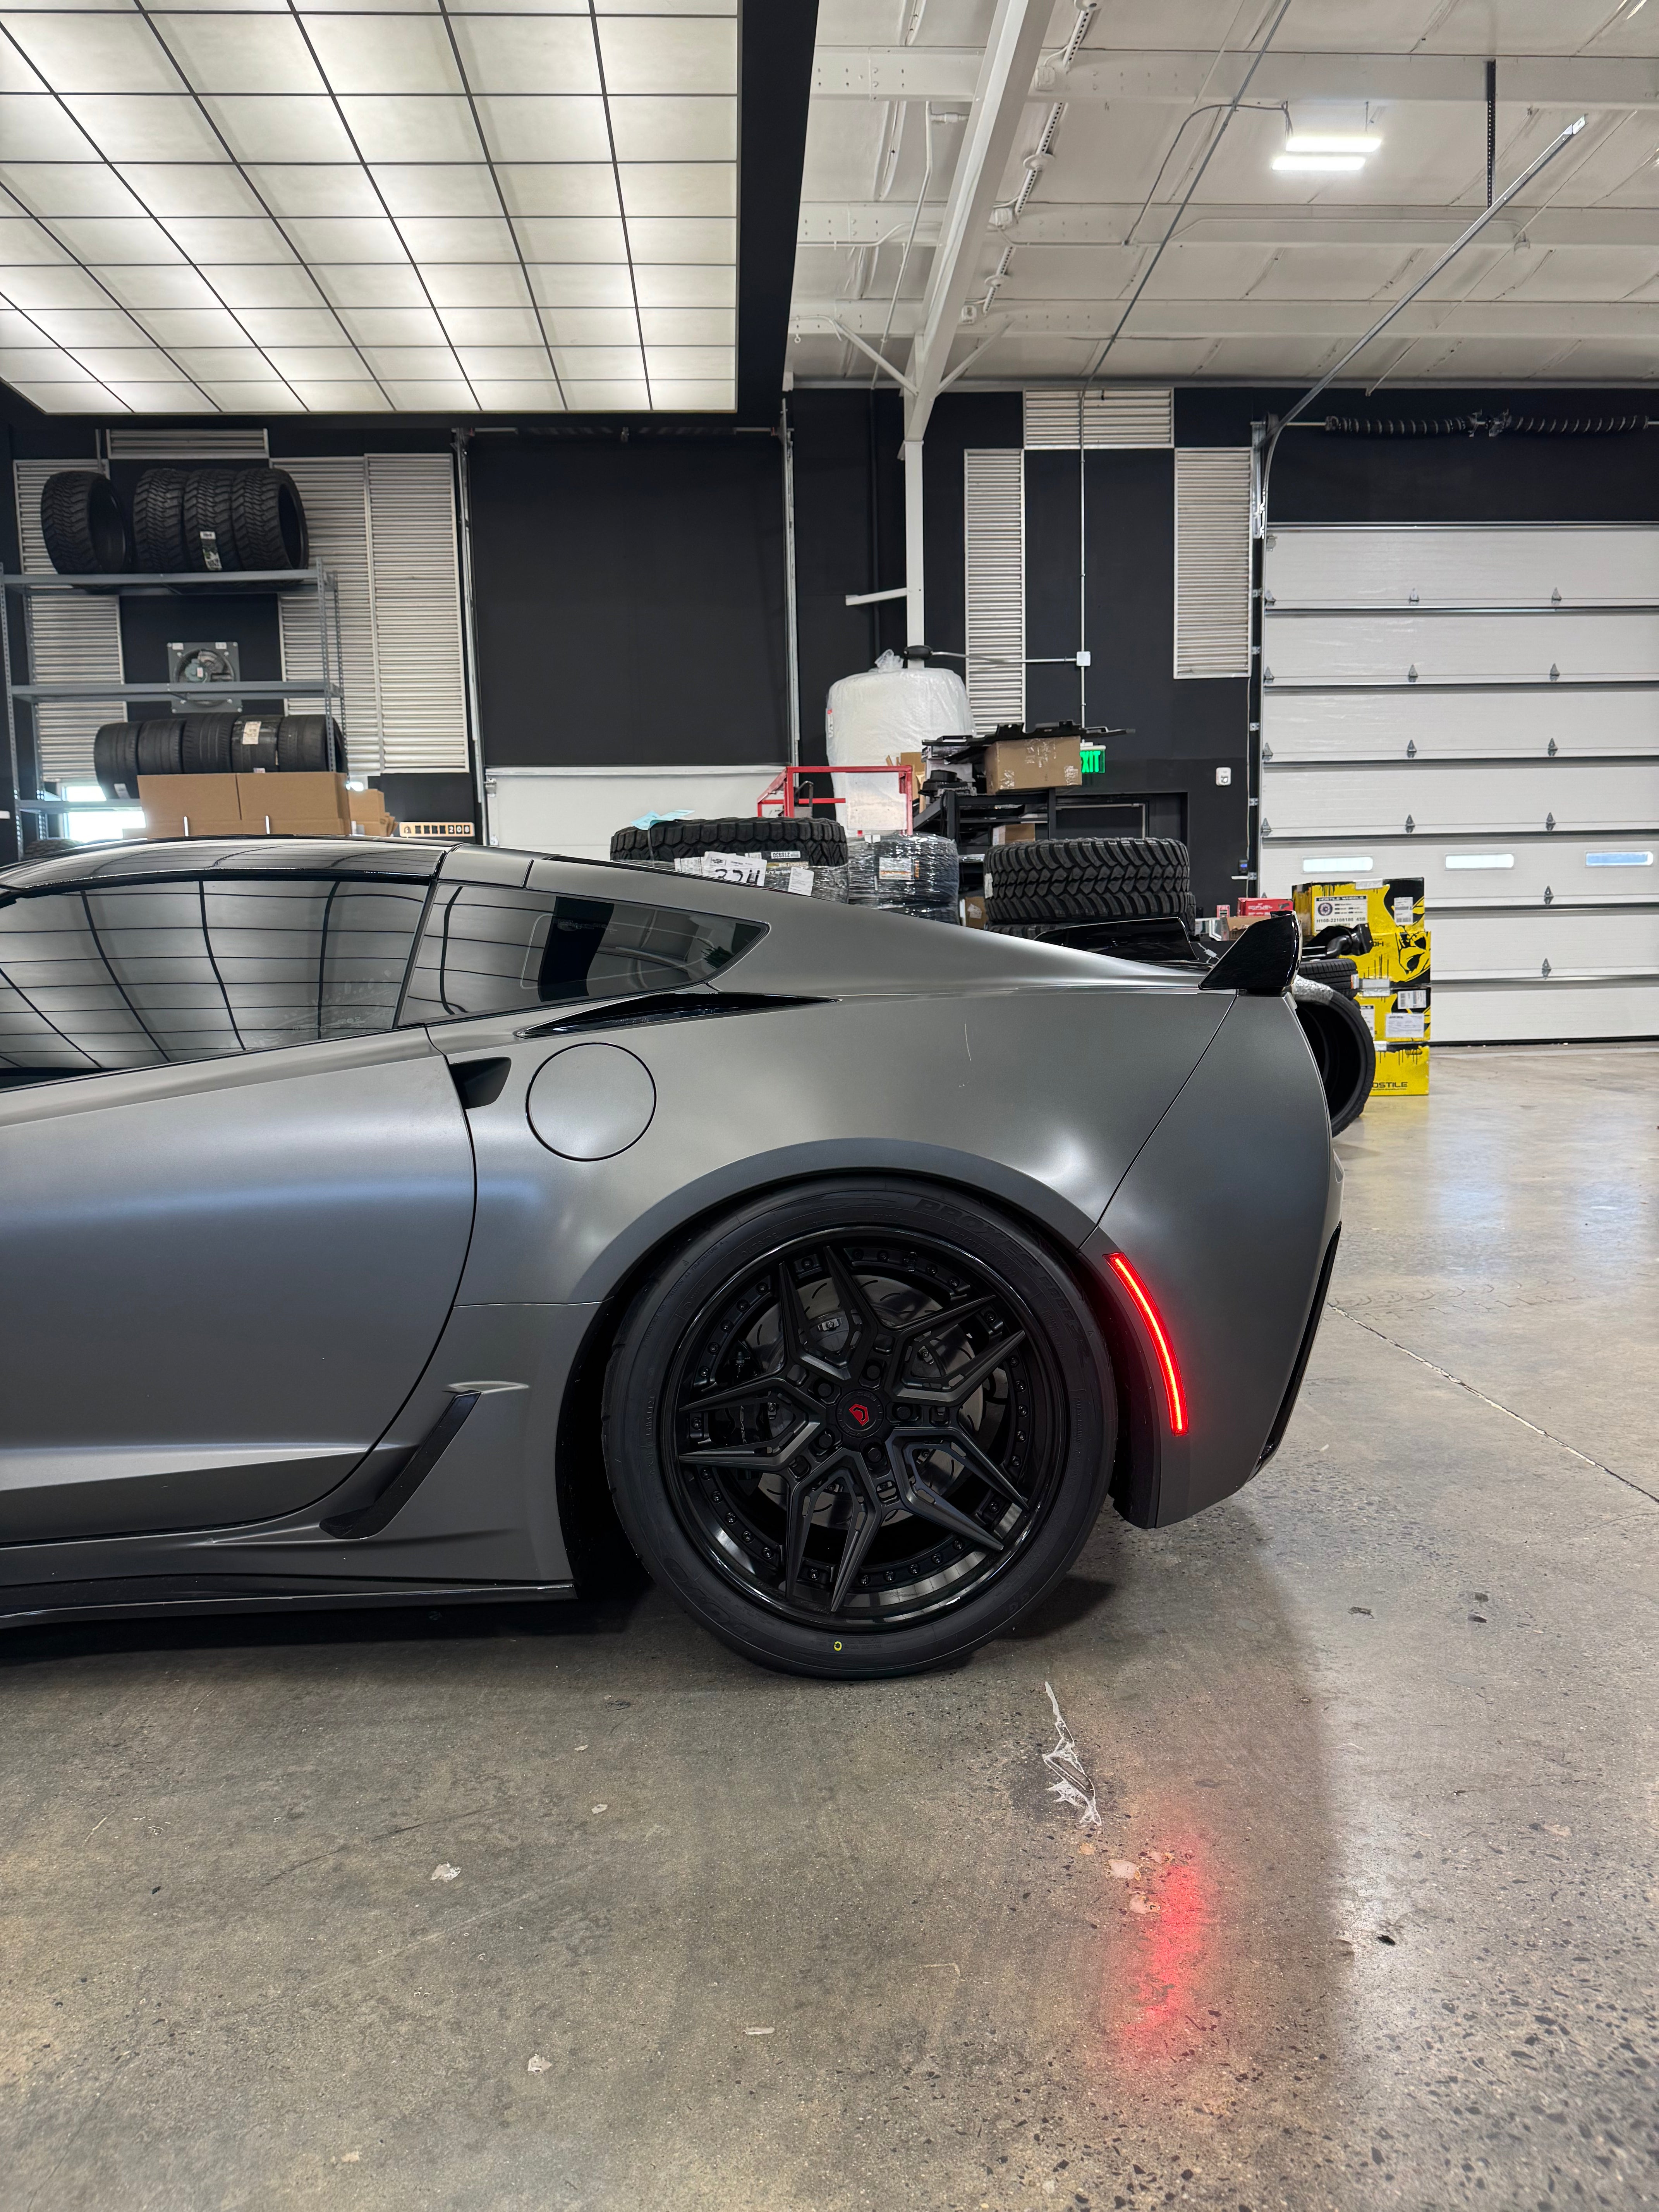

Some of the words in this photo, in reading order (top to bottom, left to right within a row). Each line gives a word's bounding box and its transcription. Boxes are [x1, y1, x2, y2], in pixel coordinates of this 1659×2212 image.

[1080, 750, 1101, 773] XIT
[740, 1231, 780, 1257] OUTSIDE
[913, 1199, 1040, 1270] PROXES
[660, 1554, 754, 1640] TOYO
